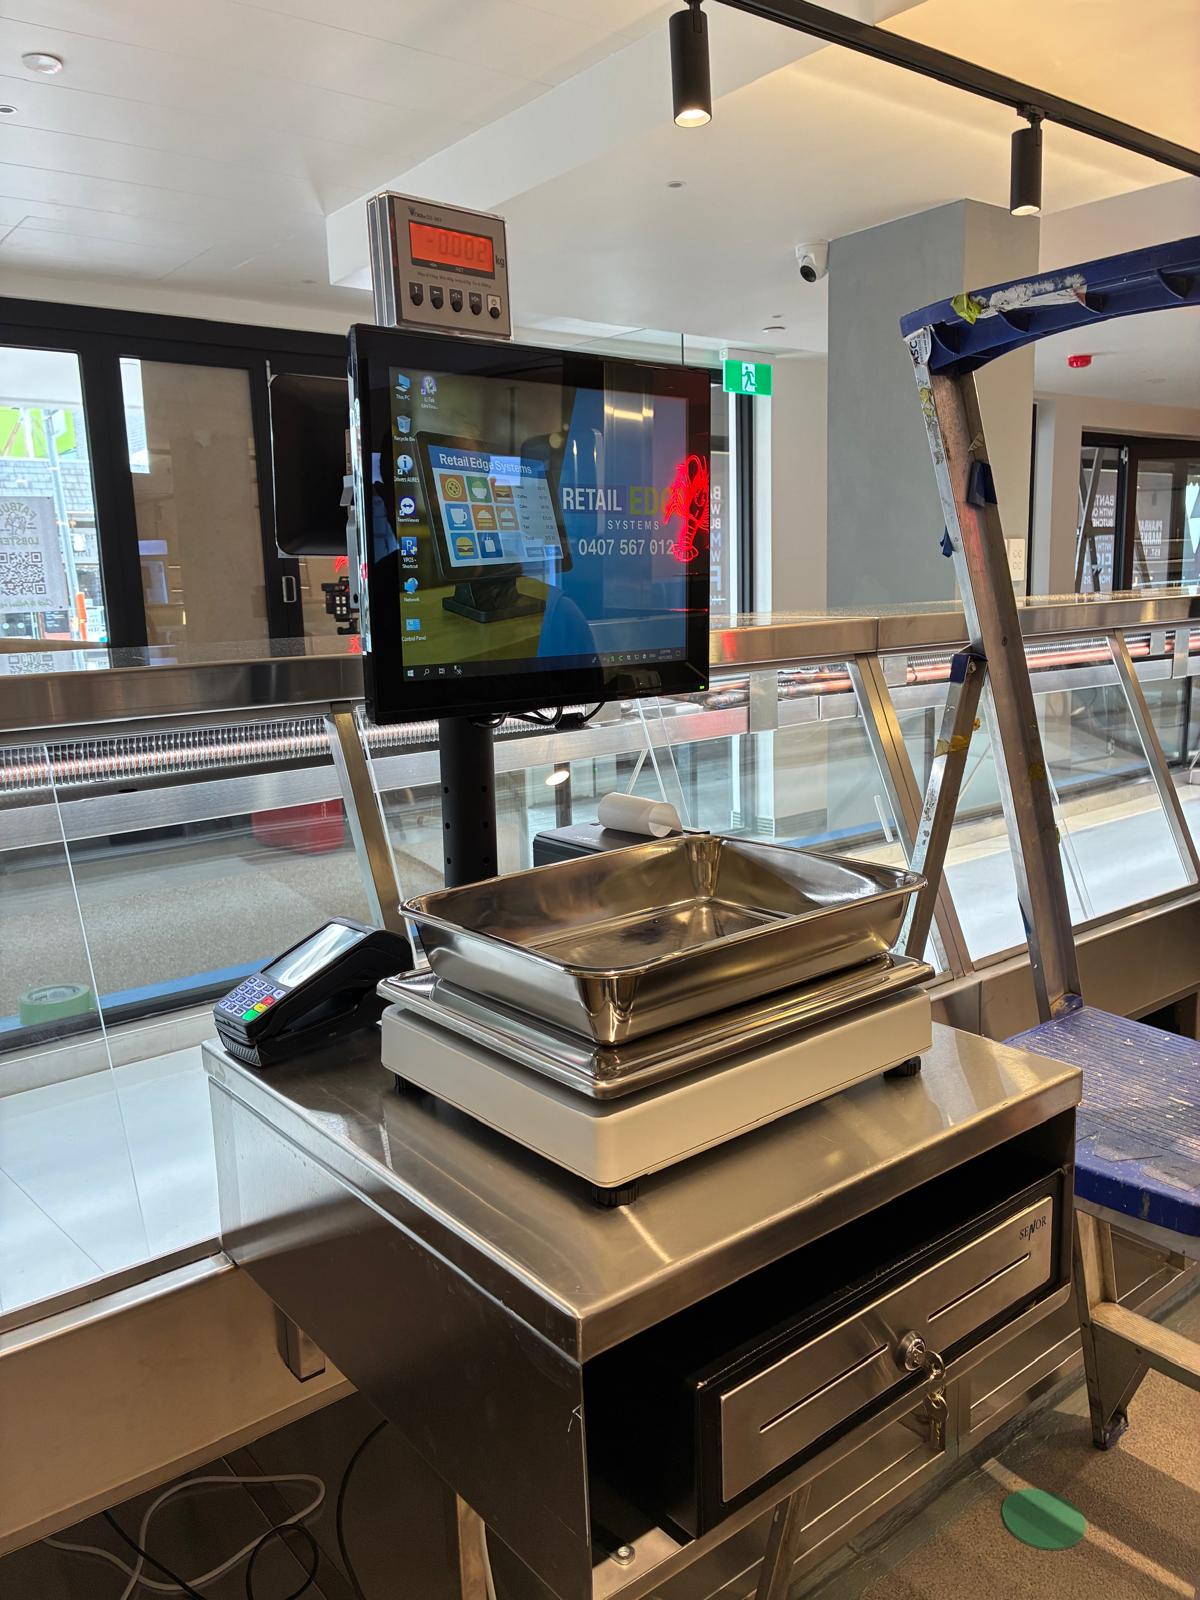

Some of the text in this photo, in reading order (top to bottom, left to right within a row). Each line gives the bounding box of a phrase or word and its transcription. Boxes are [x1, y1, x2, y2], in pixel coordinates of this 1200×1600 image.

[495, 255, 505, 268] kg
[439, 453, 532, 474] Retail Edge Systems
[562, 487, 622, 511] RETAIL
[607, 520, 660, 530] SYSTEMS
[578, 539, 675, 556] 0407 567 012
[1019, 1216, 1046, 1240] SENOR
